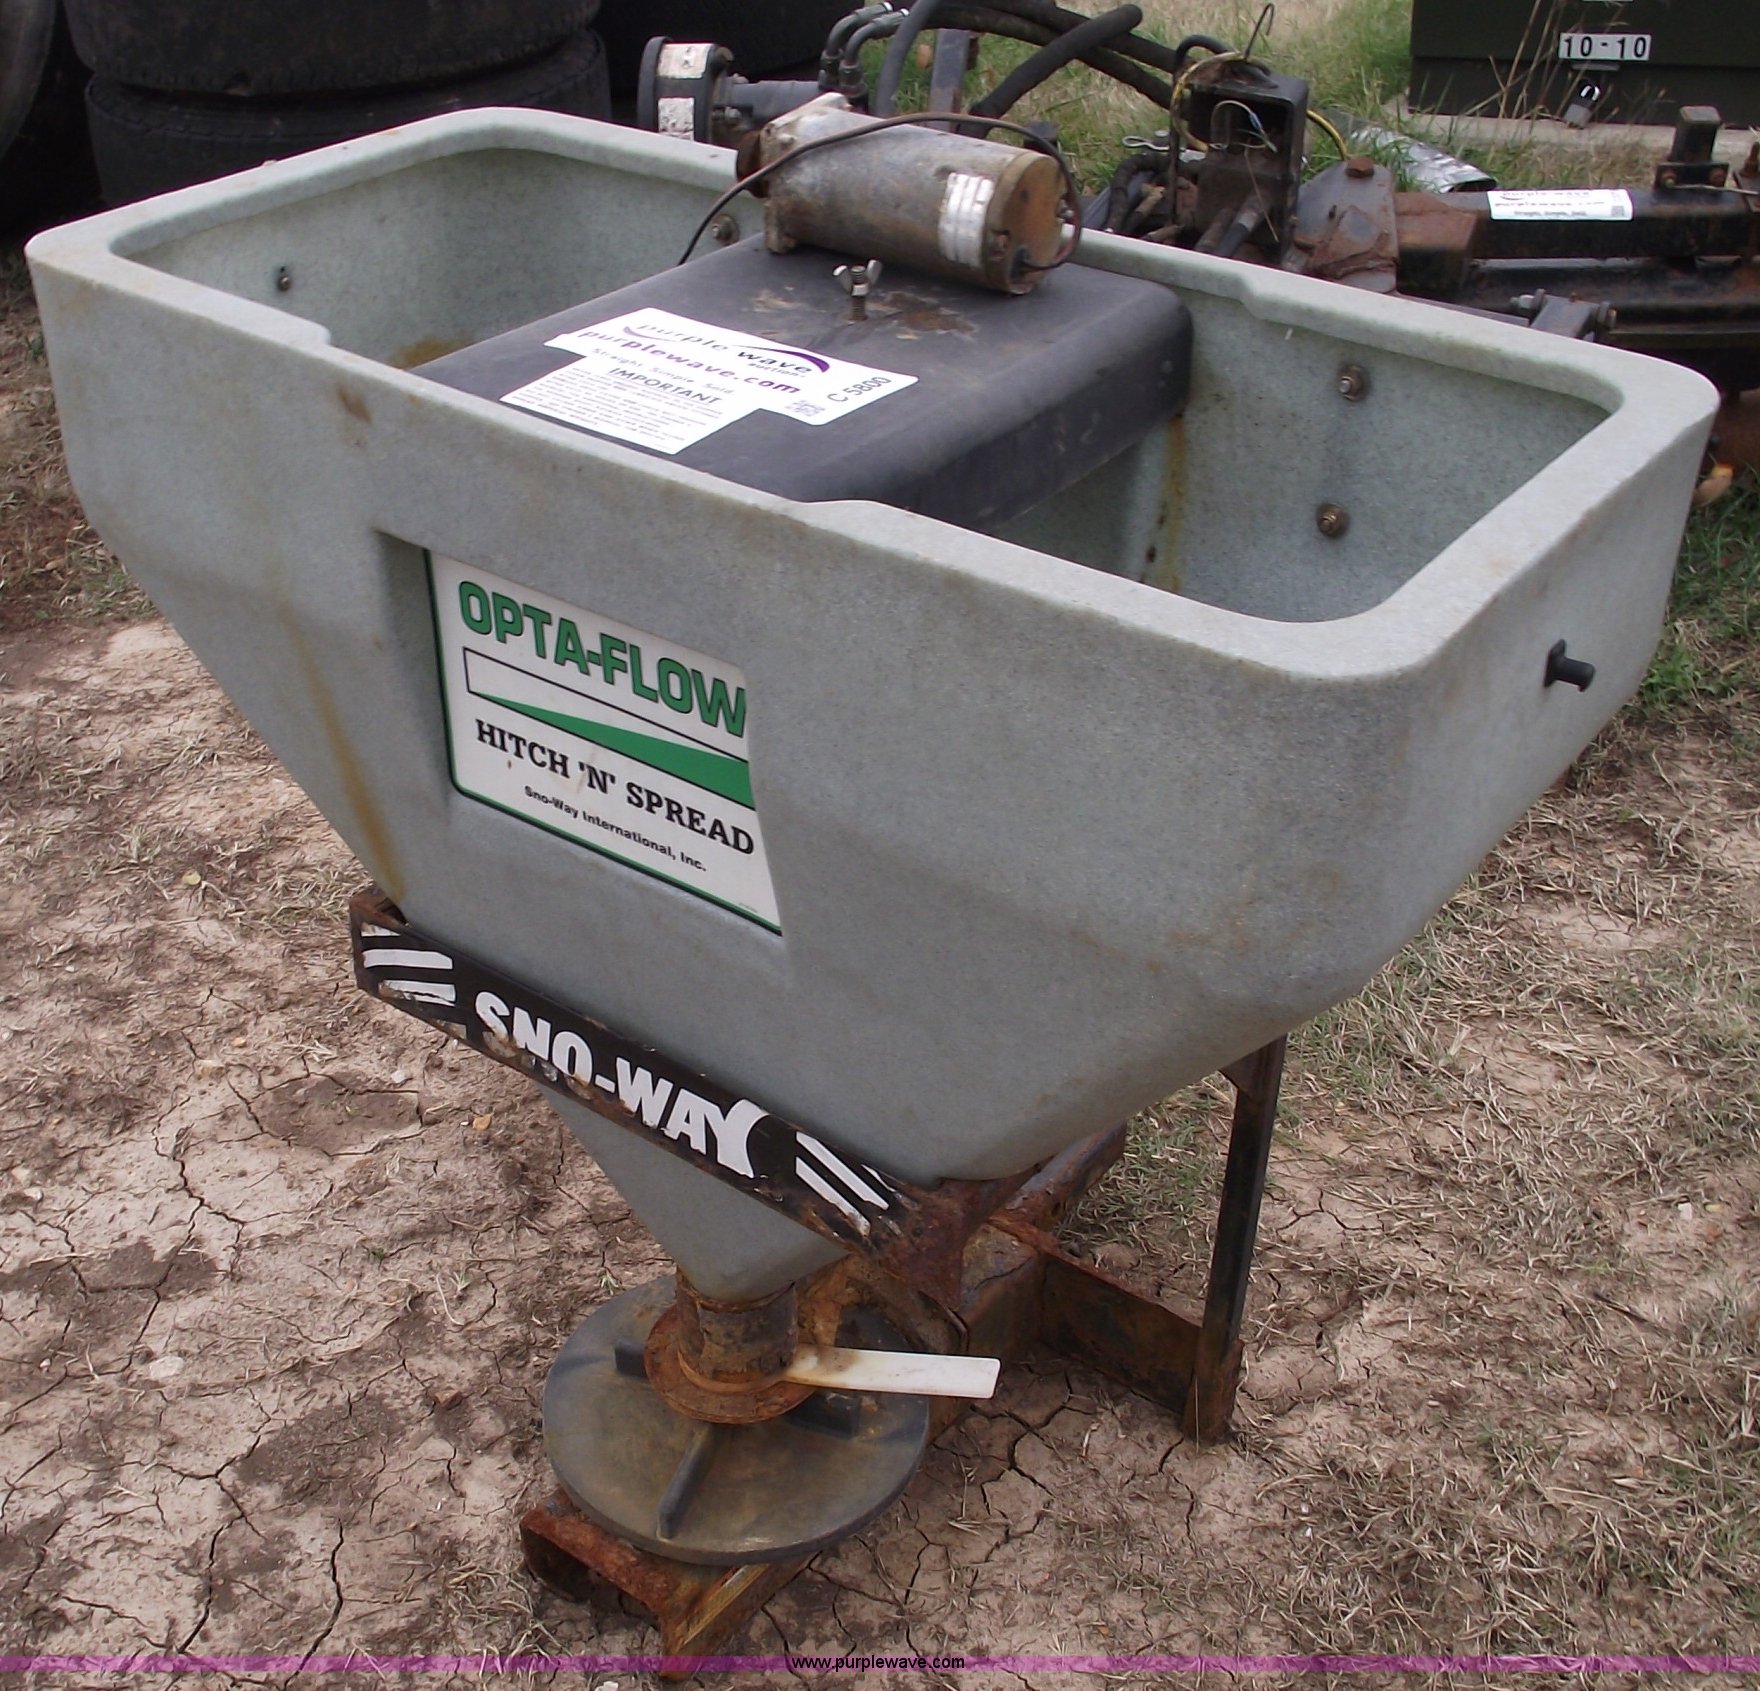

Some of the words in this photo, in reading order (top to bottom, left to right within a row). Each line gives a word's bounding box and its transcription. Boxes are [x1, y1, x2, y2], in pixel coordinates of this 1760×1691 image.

[1564, 36, 1646, 58] 10-10
[577, 331, 801, 394] purplewave.com
[637, 324, 728, 350] purple
[737, 351, 812, 373] wave
[609, 367, 722, 403] IMPORTANT
[827, 393, 849, 402] C
[847, 376, 892, 396] 5800
[458, 580, 747, 739] OPTA-FLOW
[475, 719, 571, 779] HITCH
[578, 761, 616, 794] 'N'
[626, 781, 755, 855] SPREAD
[524, 785, 580, 819] Sno-Way
[582, 810, 677, 861] International,
[680, 851, 707, 872] Inc.
[475, 990, 770, 1178] SNO-WAY
